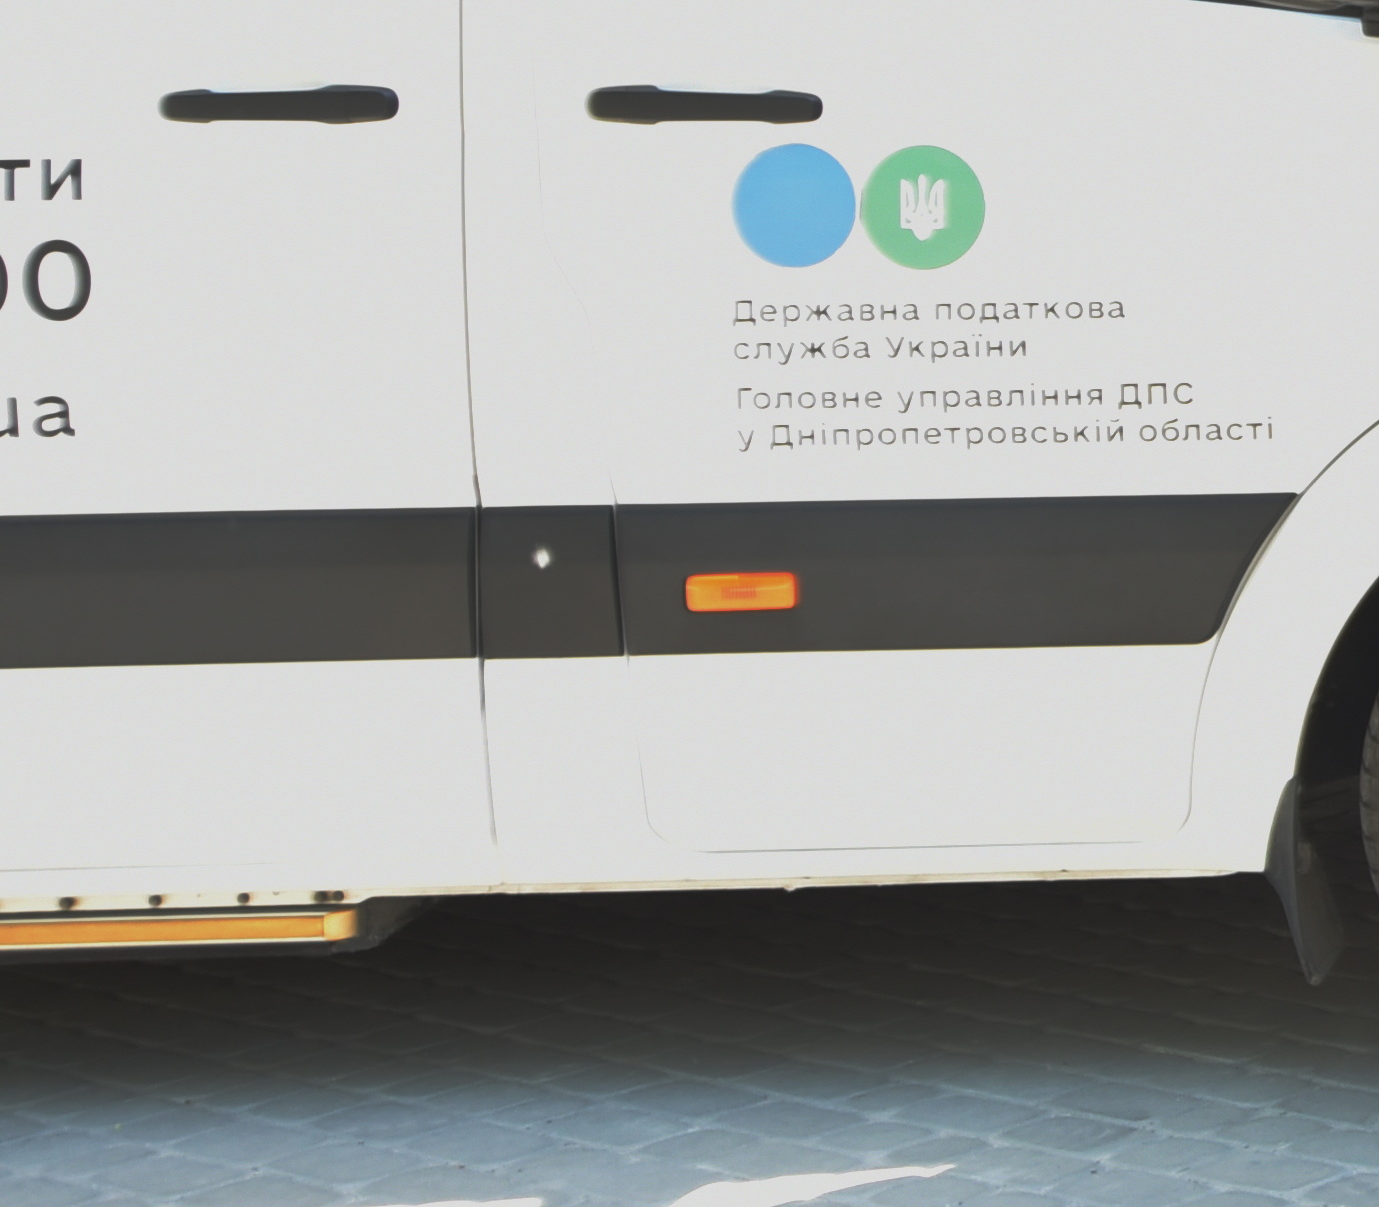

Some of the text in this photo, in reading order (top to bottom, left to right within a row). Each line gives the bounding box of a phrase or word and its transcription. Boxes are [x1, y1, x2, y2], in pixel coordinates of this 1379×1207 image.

[732, 299, 1126, 327] Державна податкова
[733, 333, 1027, 365] служба України
[737, 382, 1194, 413] Головне управління ДПС
[737, 416, 1273, 452] у Дніпропетровській області
